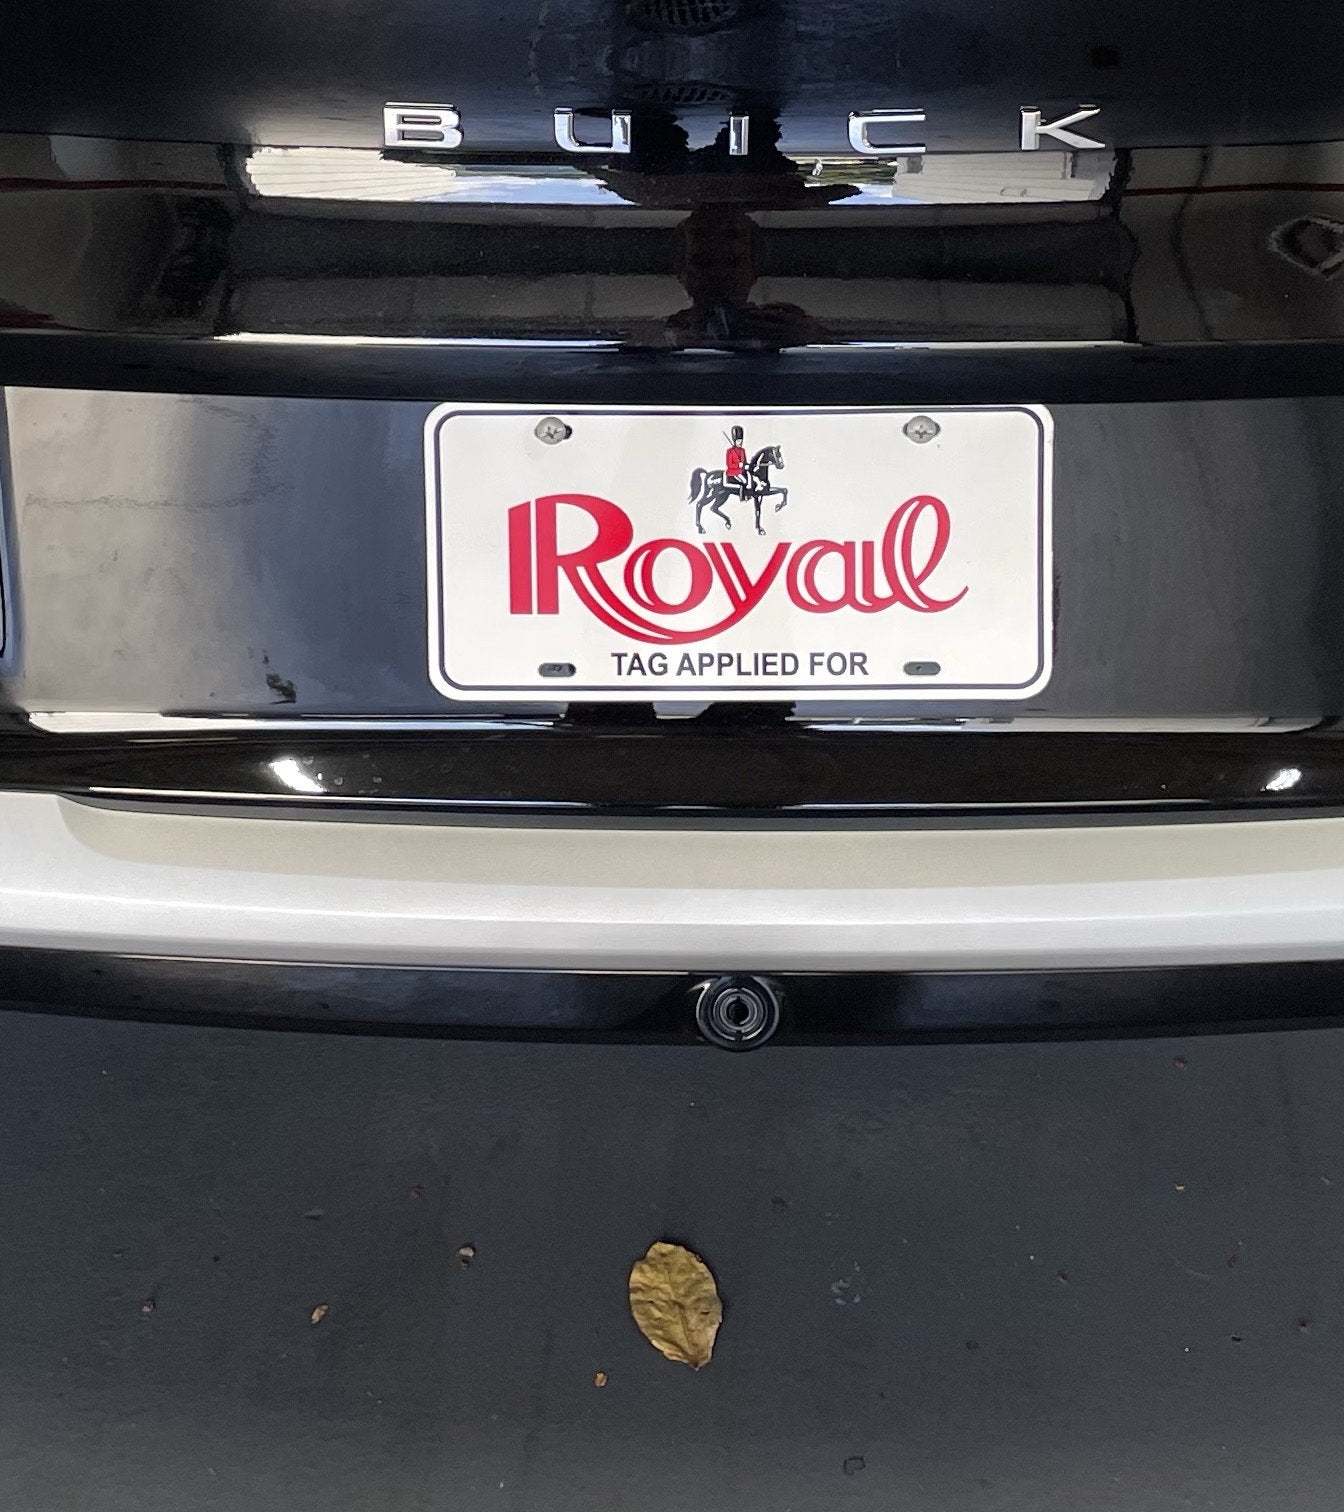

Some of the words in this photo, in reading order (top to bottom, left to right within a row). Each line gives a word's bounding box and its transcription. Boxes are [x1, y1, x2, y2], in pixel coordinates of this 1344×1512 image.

[383, 101, 1106, 156] BUICK
[507, 493, 969, 645] Royal
[611, 651, 669, 676] TAG
[676, 651, 799, 676] APPLIED
[809, 651, 869, 676] FOR
